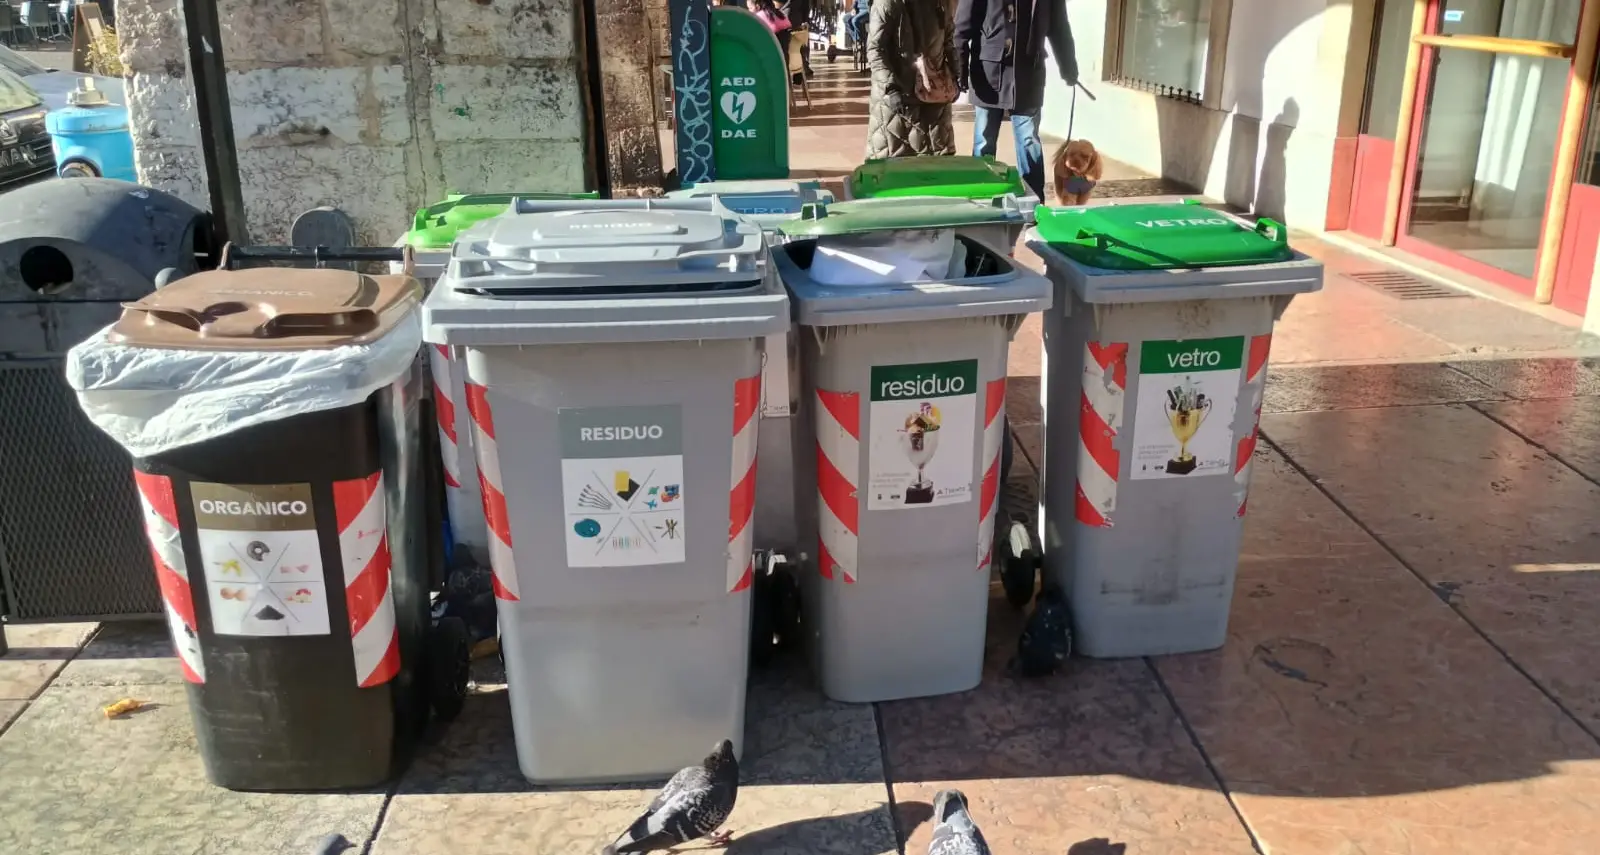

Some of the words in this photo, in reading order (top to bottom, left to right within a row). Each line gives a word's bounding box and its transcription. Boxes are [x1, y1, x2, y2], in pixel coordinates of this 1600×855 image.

[720, 77, 756, 87] AED
[721, 129, 757, 138] DAE
[1135, 218, 1228, 228] VETRO
[1167, 348, 1221, 368] vetro
[881, 373, 965, 397] residuo
[580, 425, 663, 441] RESIDUO
[199, 499, 307, 515] ORGANICO
